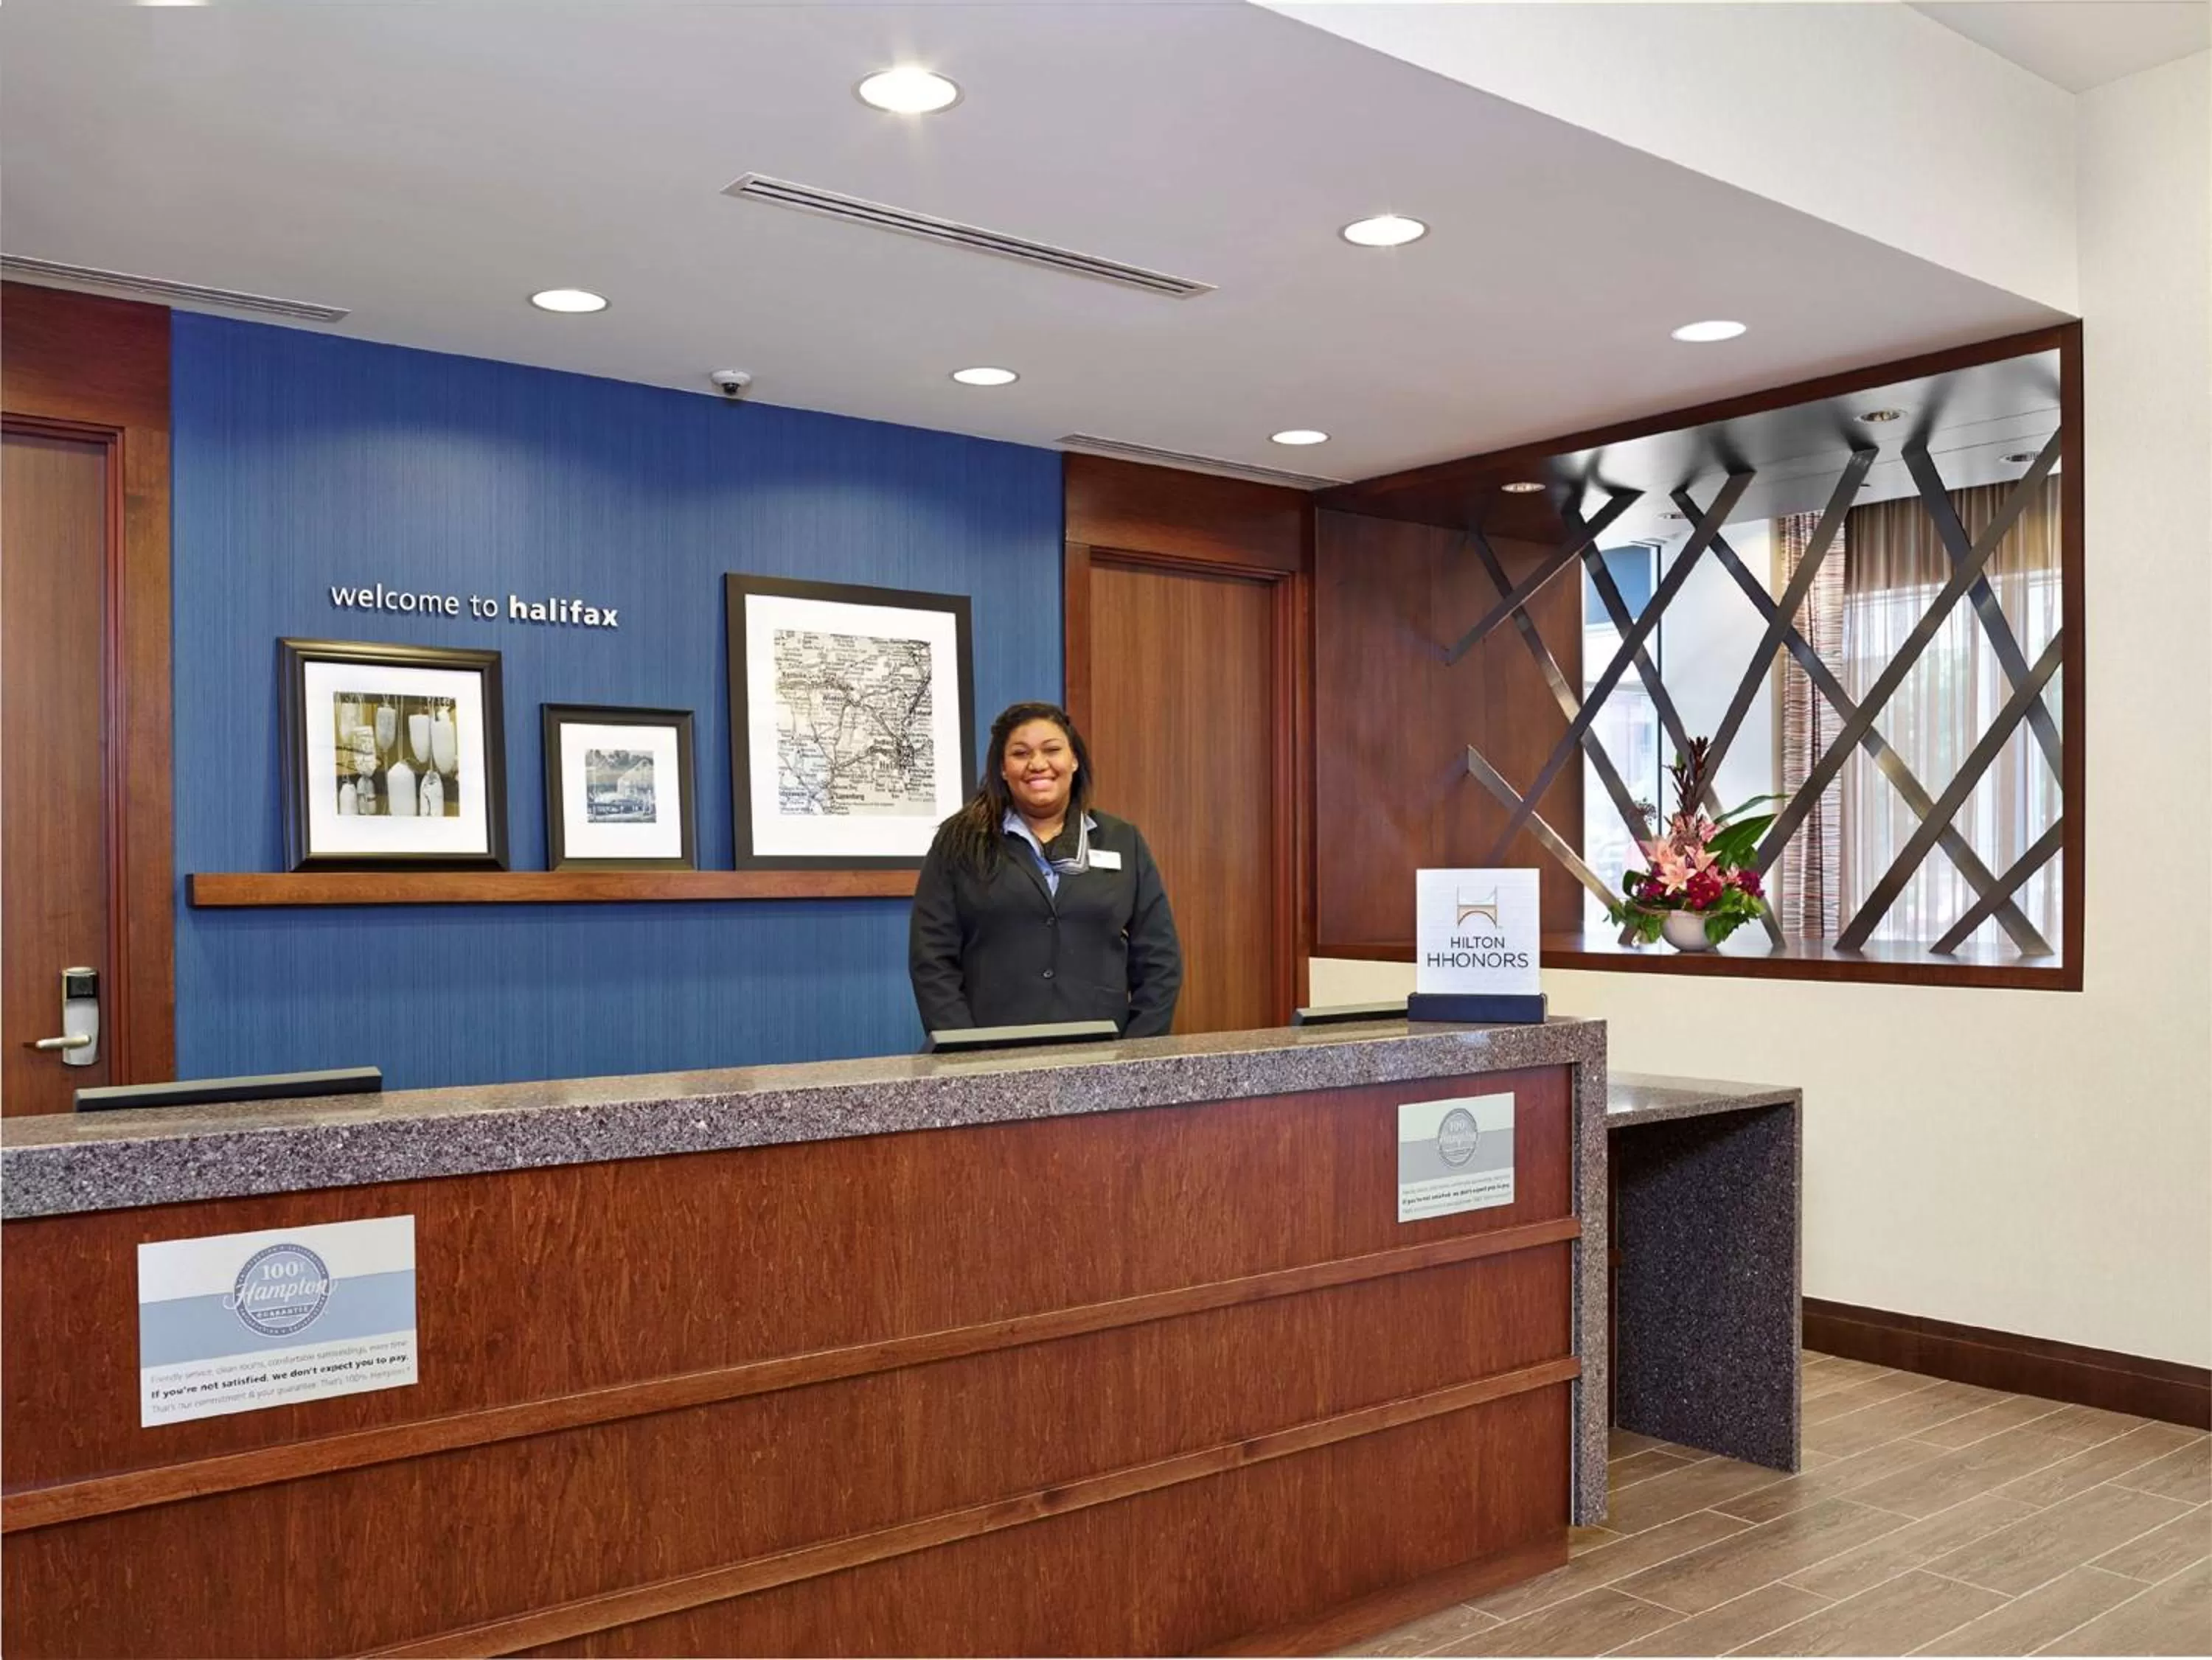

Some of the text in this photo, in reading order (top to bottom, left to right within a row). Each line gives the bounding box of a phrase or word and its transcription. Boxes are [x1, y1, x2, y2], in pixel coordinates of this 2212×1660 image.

[330, 582, 619, 628] welcome to halifax
[1450, 936, 1505, 949] HILTON
[1427, 952, 1528, 969] HHONORS
[223, 1275, 339, 1309] Hampton
[151, 1390, 159, 1399] If
[163, 1386, 198, 1399] you're
[200, 1381, 219, 1392] not
[272, 1372, 288, 1381] we
[290, 1366, 318, 1378] don't
[320, 1361, 353, 1373] expect
[355, 1359, 375, 1370] you
[376, 1356, 388, 1364] to
